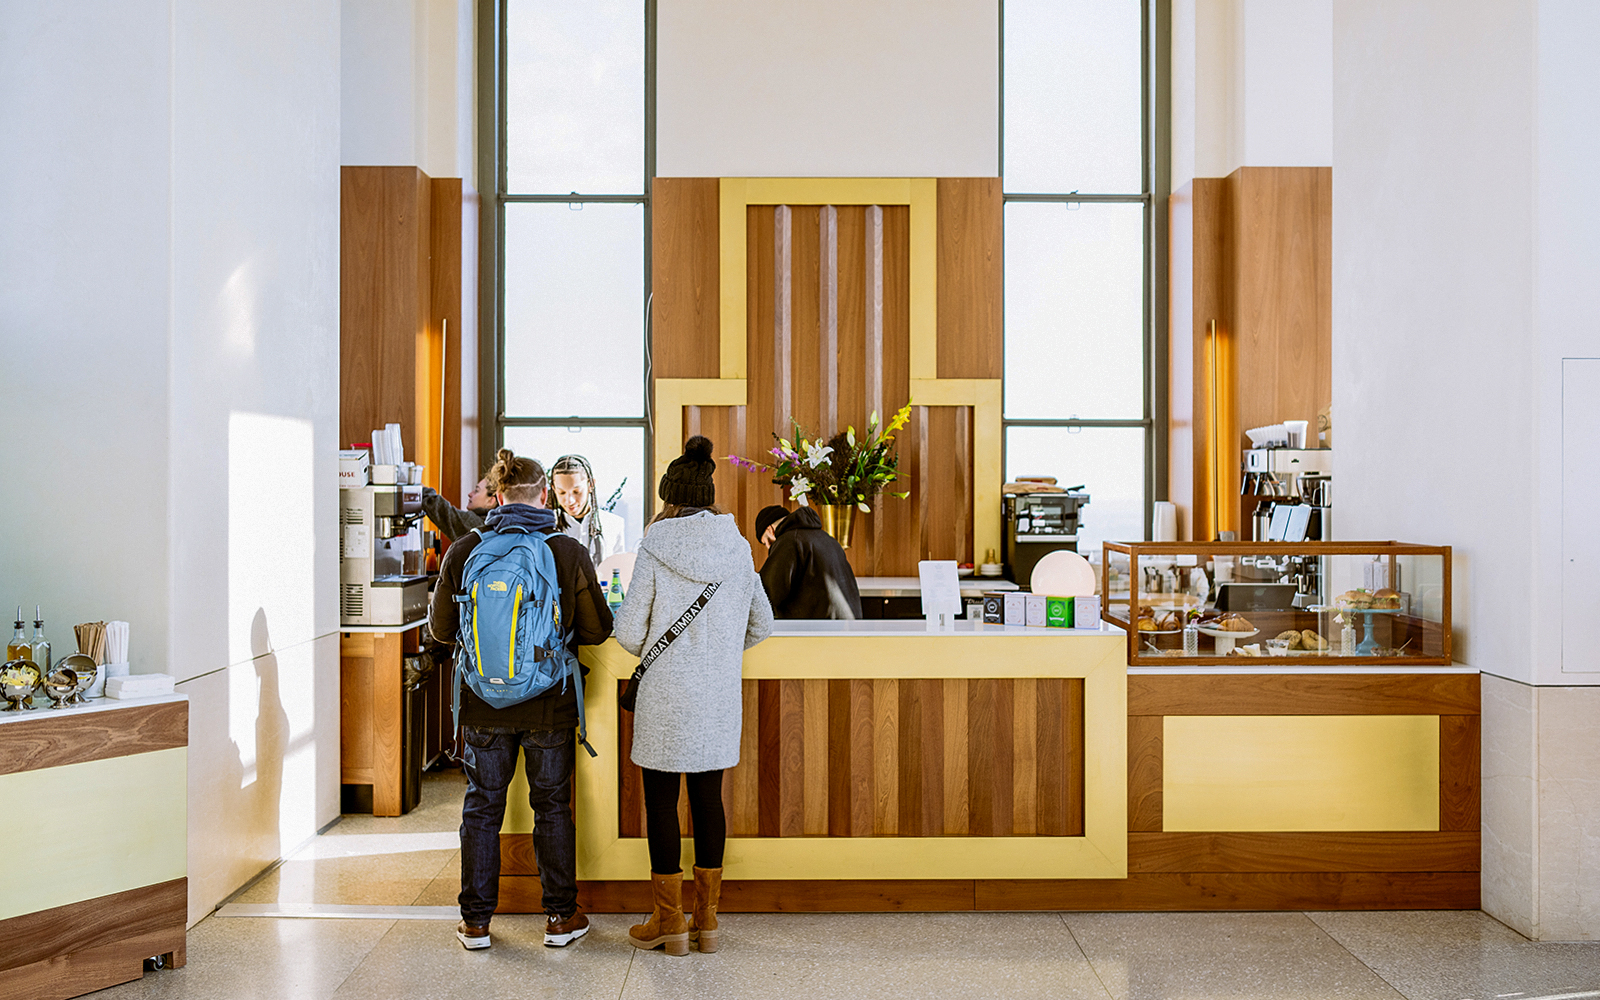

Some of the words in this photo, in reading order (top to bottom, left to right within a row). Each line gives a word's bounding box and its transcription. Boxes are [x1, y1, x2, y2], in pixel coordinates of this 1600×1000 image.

[642, 635, 670, 669] BIMBAY
[670, 601, 702, 636] BIMBAY
[702, 582, 719, 600] BIM
